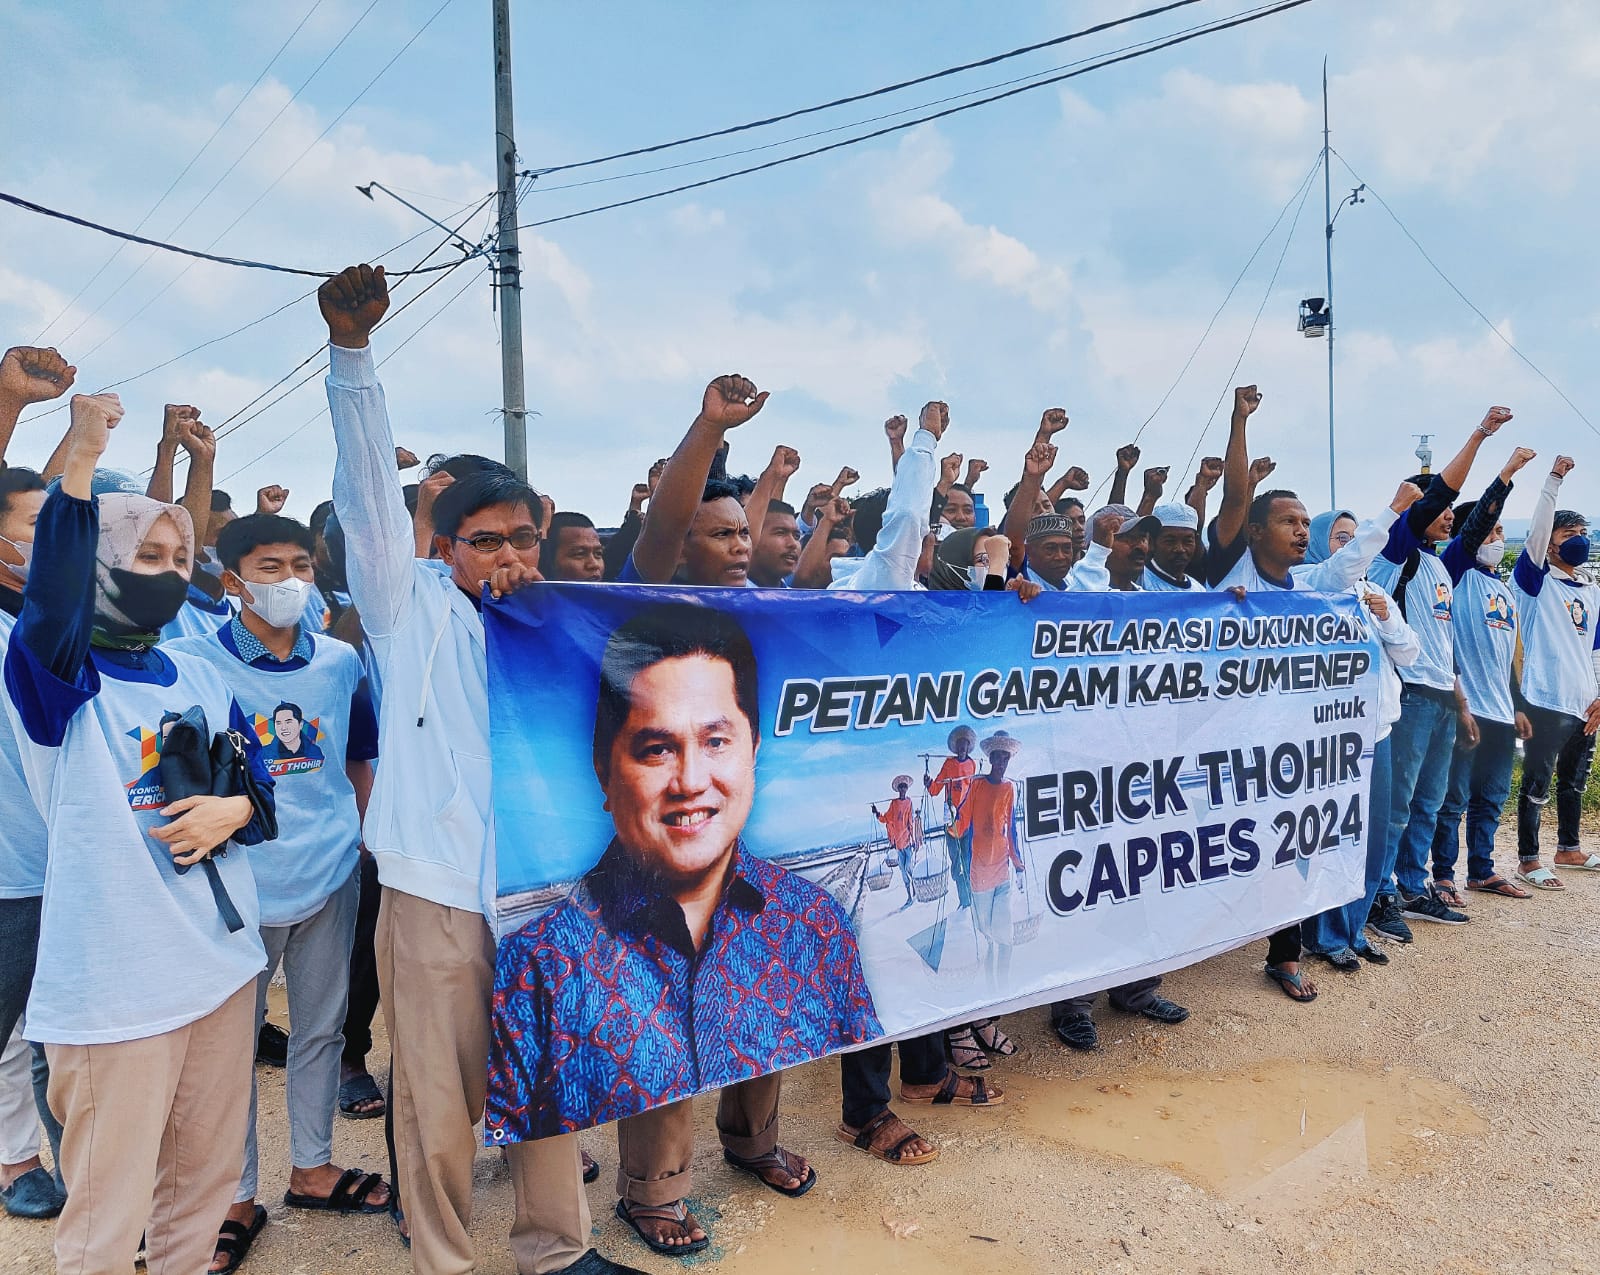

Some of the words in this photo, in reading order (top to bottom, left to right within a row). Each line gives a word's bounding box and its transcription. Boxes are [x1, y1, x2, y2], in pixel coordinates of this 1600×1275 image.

[1033, 618, 1212, 657] DEKLARASI
[1217, 616, 1368, 649] DUKUNGAN
[775, 672, 964, 736] PETANI
[967, 664, 1121, 719] GARAM
[1127, 660, 1210, 705] KAB.
[1214, 651, 1370, 699] SUMENEP
[1313, 699, 1365, 724] untuk
[287, 759, 321, 771] THOHIR
[1025, 755, 1188, 840] ERICK
[1197, 731, 1363, 810] THOHIR
[129, 785, 160, 796] KONCO
[1046, 817, 1261, 916] CAPRES
[1272, 793, 1363, 869] 2024
